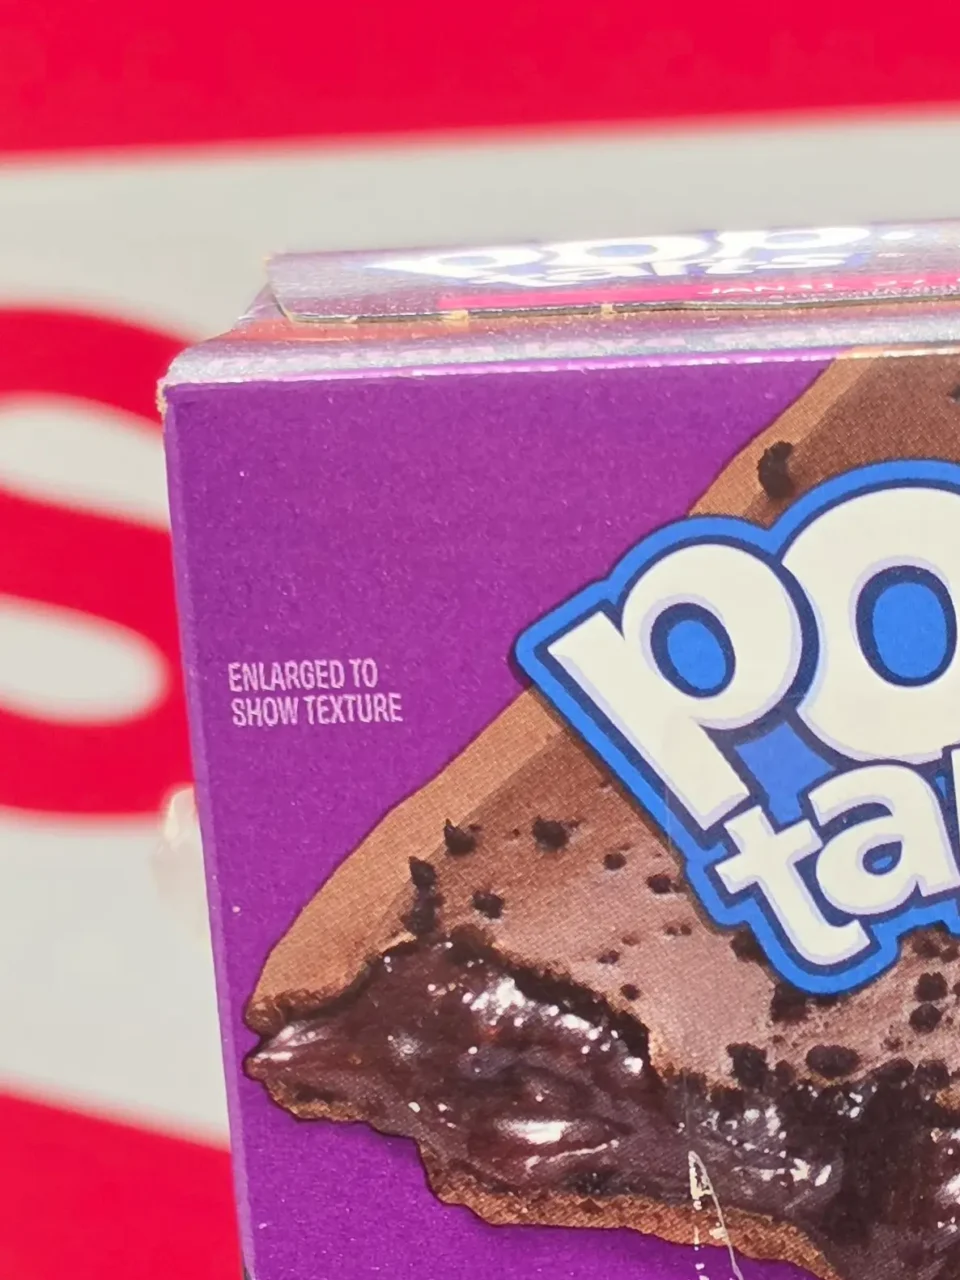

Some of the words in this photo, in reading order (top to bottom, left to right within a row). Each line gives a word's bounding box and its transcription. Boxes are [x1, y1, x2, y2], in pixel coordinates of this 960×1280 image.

[228, 659, 345, 692] ENLARGED
[349, 657, 379, 688] TO
[231, 696, 300, 727] SHOW
[302, 693, 404, 725] TEXTURE
